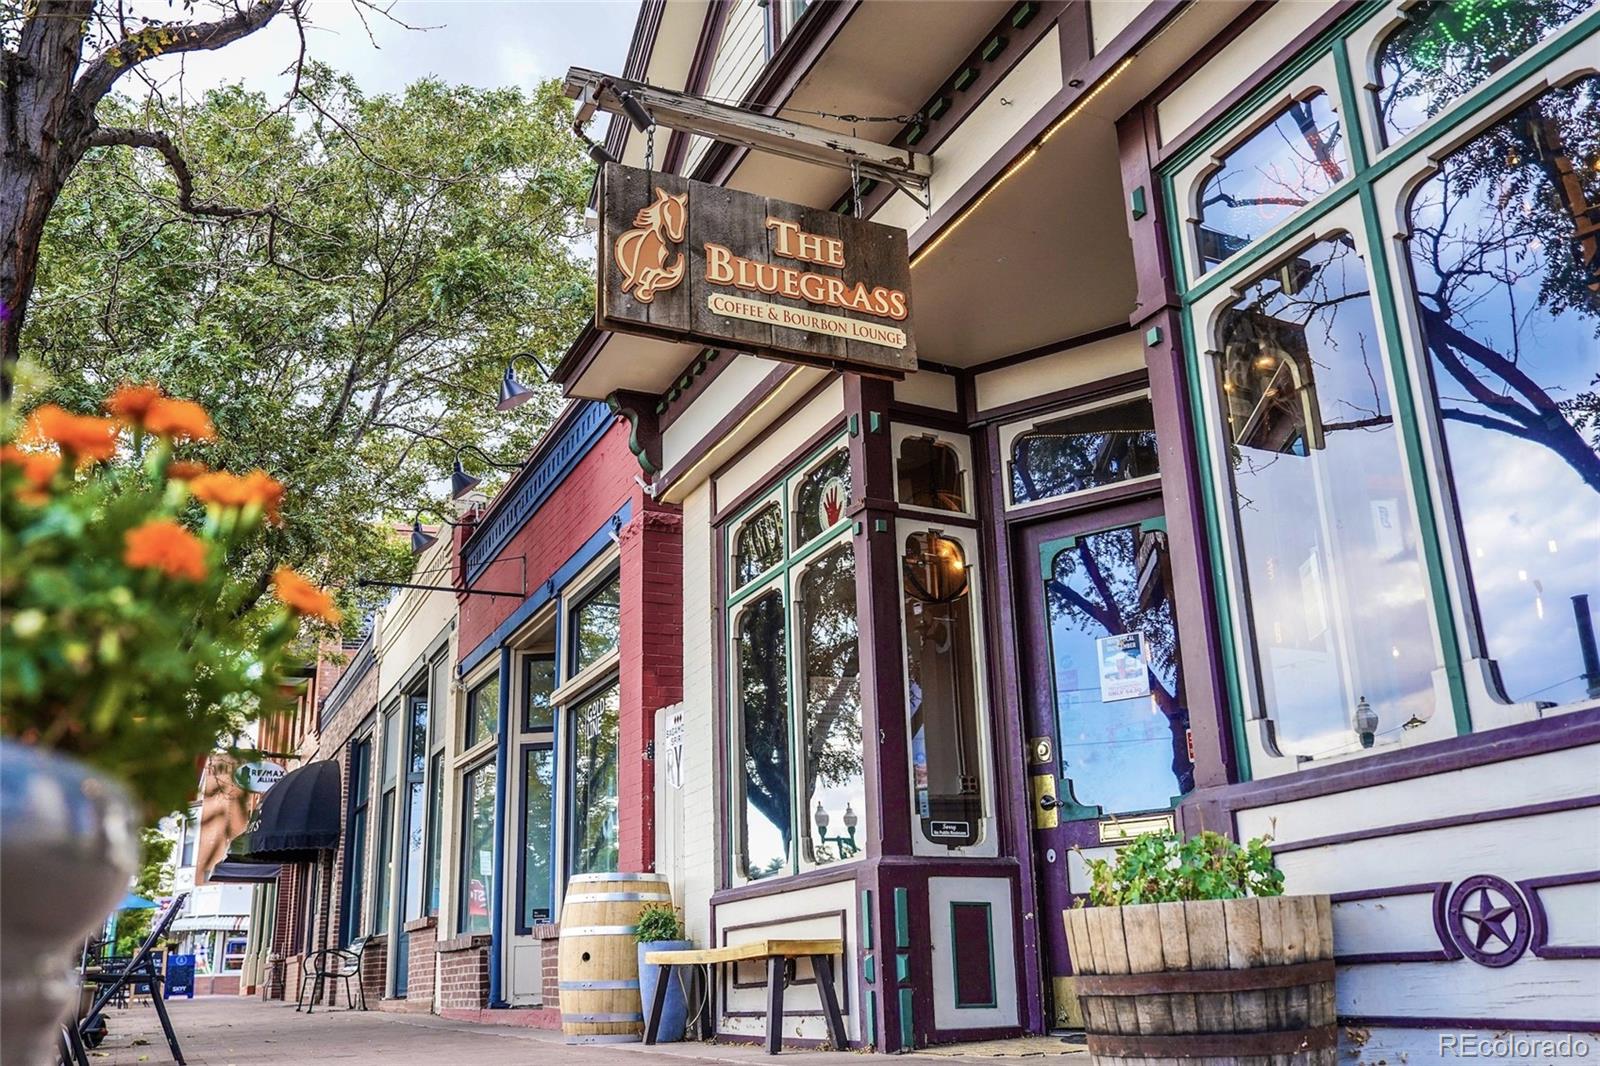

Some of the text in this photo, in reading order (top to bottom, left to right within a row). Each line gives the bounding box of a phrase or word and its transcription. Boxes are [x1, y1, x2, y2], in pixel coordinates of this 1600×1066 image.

[767, 218, 844, 266] THE
[705, 243, 907, 318] BLUEGRASS
[713, 297, 903, 345] COFFEE & BOURBON LOUNGE
[251, 769, 285, 778] RE/MAX
